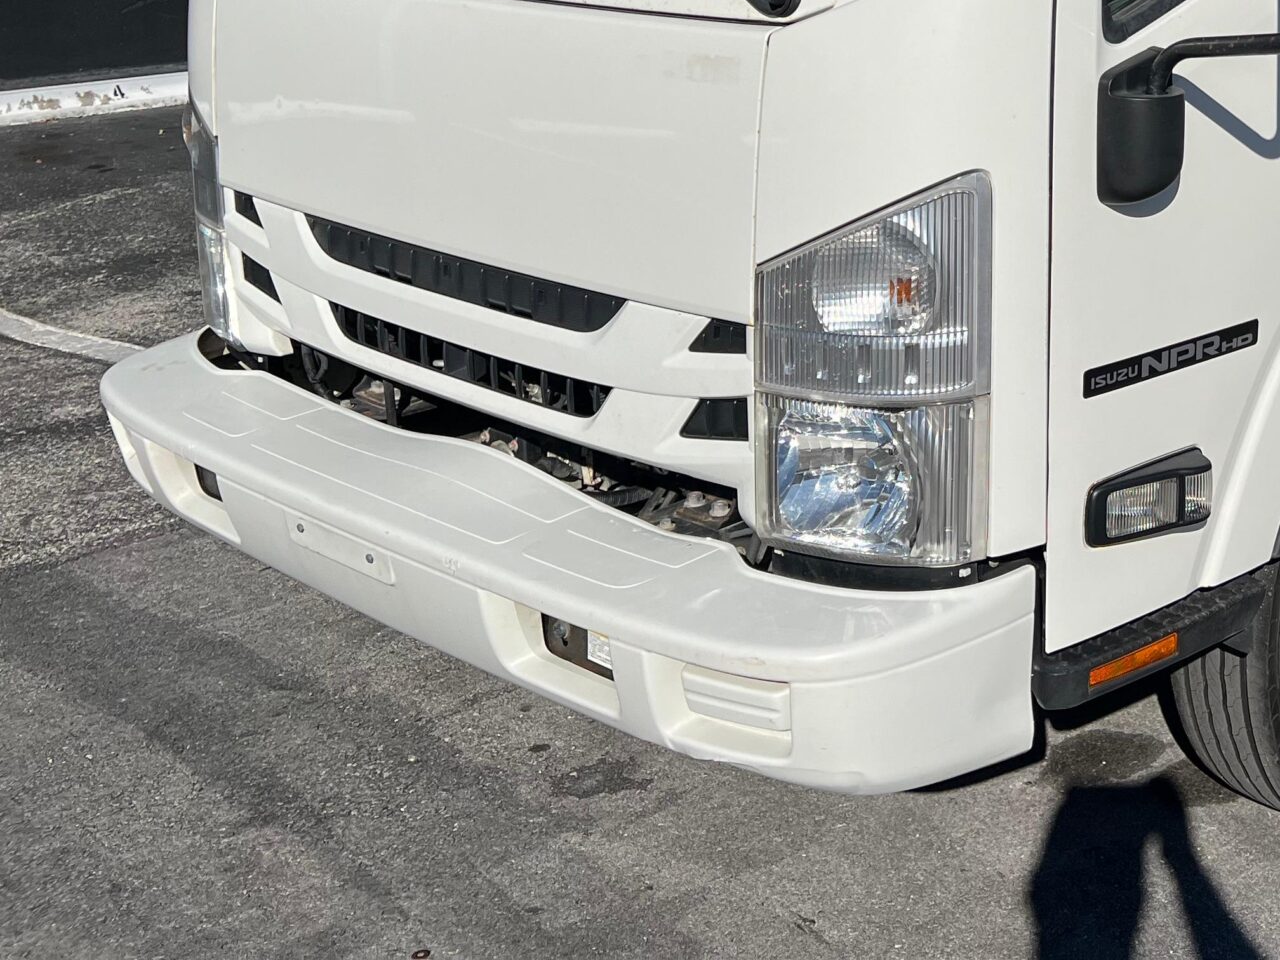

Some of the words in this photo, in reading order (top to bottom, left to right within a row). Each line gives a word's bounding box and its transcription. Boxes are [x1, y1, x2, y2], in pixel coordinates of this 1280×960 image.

[1090, 364, 1139, 390] ISUZU
[1141, 335, 1221, 378] NPR
[1221, 332, 1253, 352] HD
